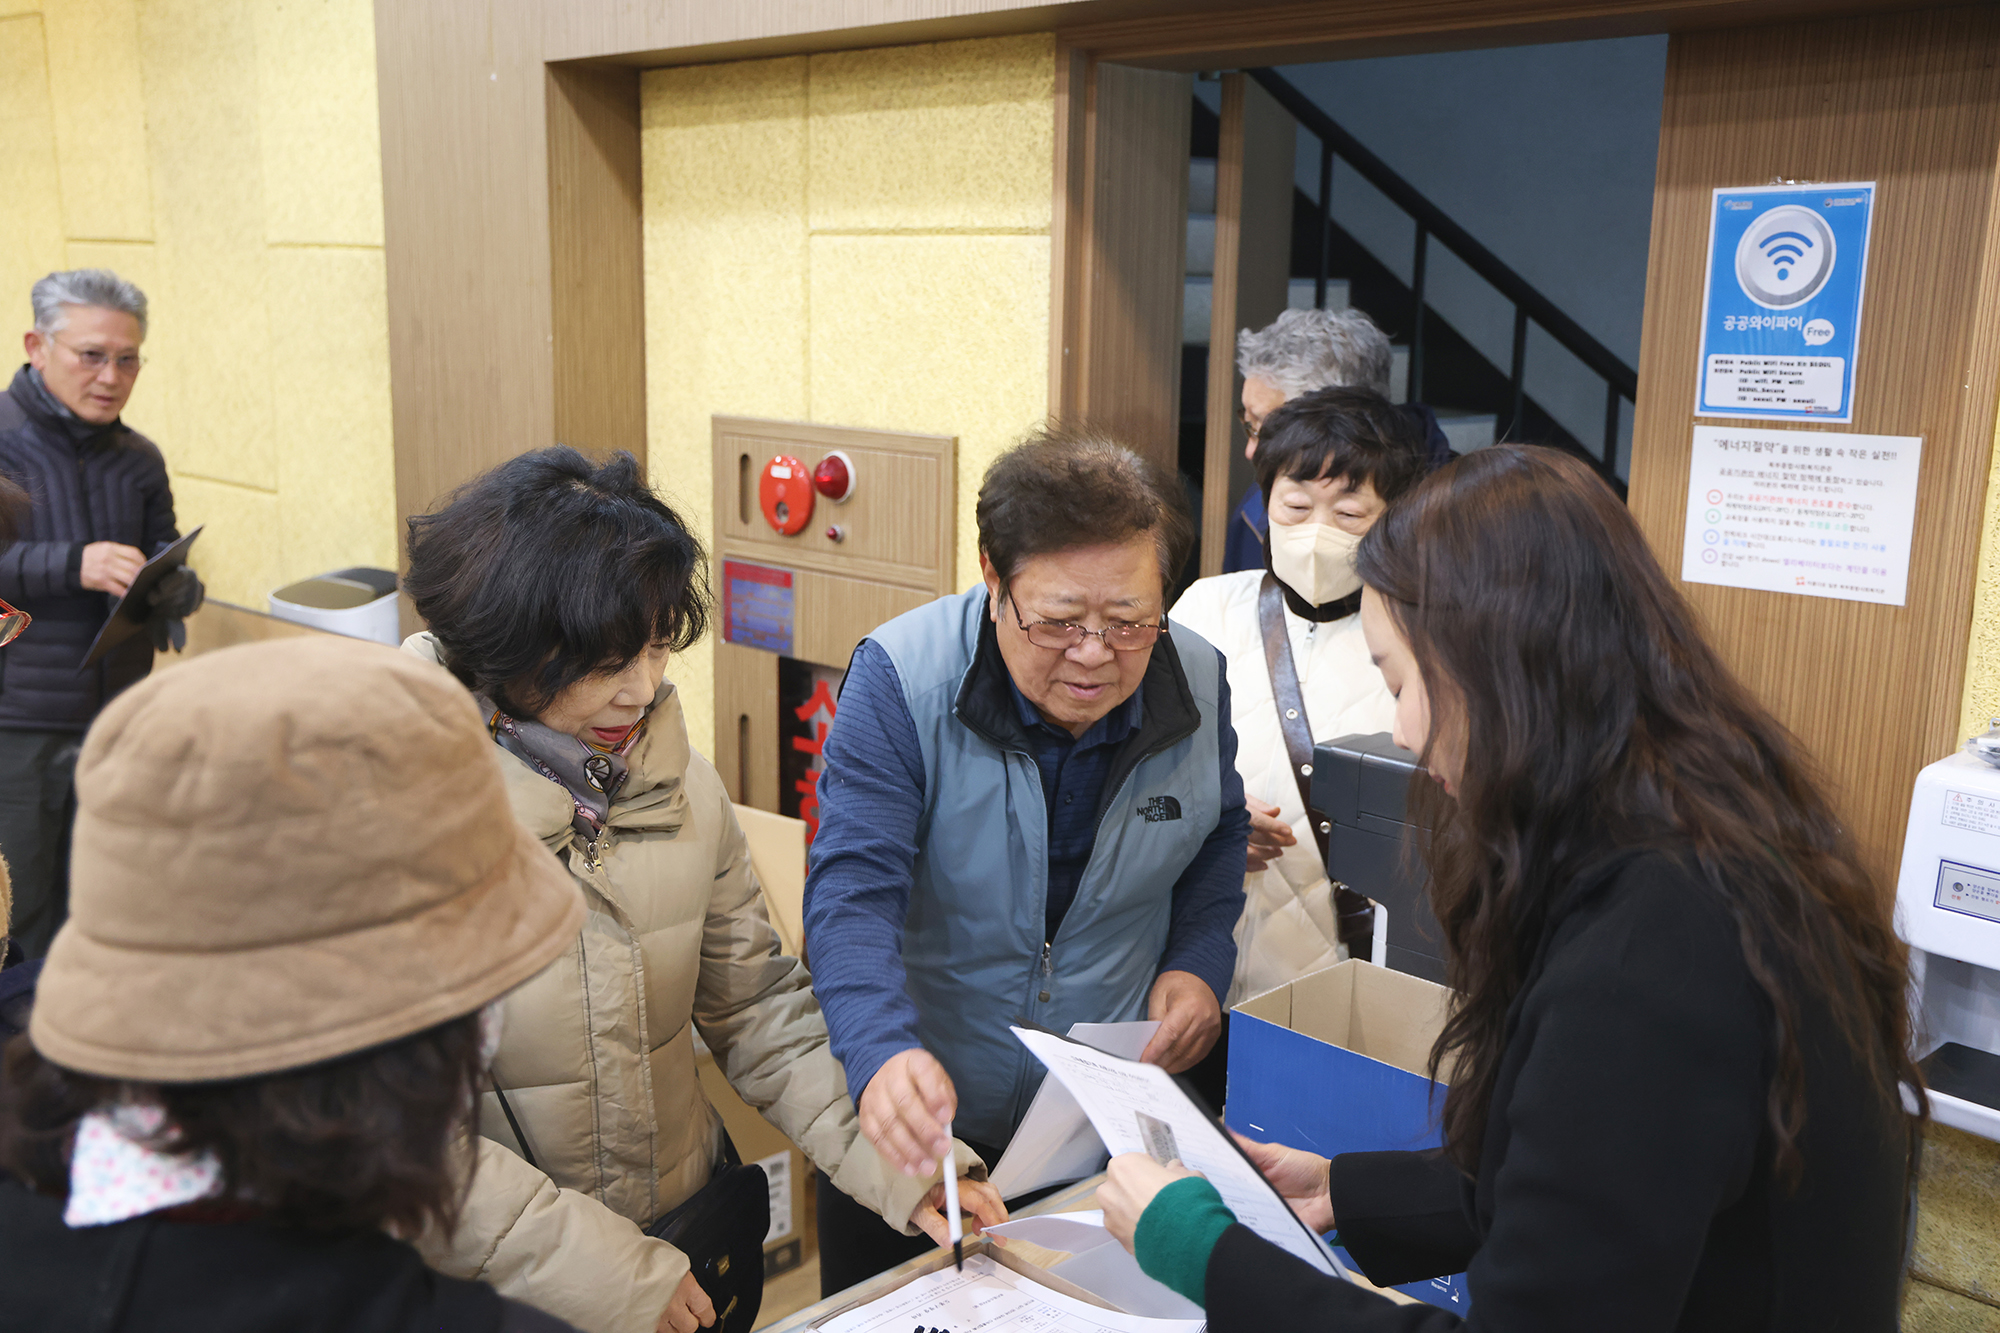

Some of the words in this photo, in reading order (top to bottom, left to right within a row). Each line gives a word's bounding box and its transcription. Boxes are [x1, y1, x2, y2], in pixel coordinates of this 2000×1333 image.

[1723, 315, 1803, 331] 공공와이파이
[1807, 327, 1831, 336] Free
[1793, 445, 1810, 456] 위한
[1815, 447, 1832, 457] 생활
[1836, 448, 1845, 457] 속
[1849, 448, 1867, 460] 작은
[1148, 797, 1165, 806] THE
[1137, 803, 1165, 817] NORTH
[1145, 812, 1167, 824] FACE
